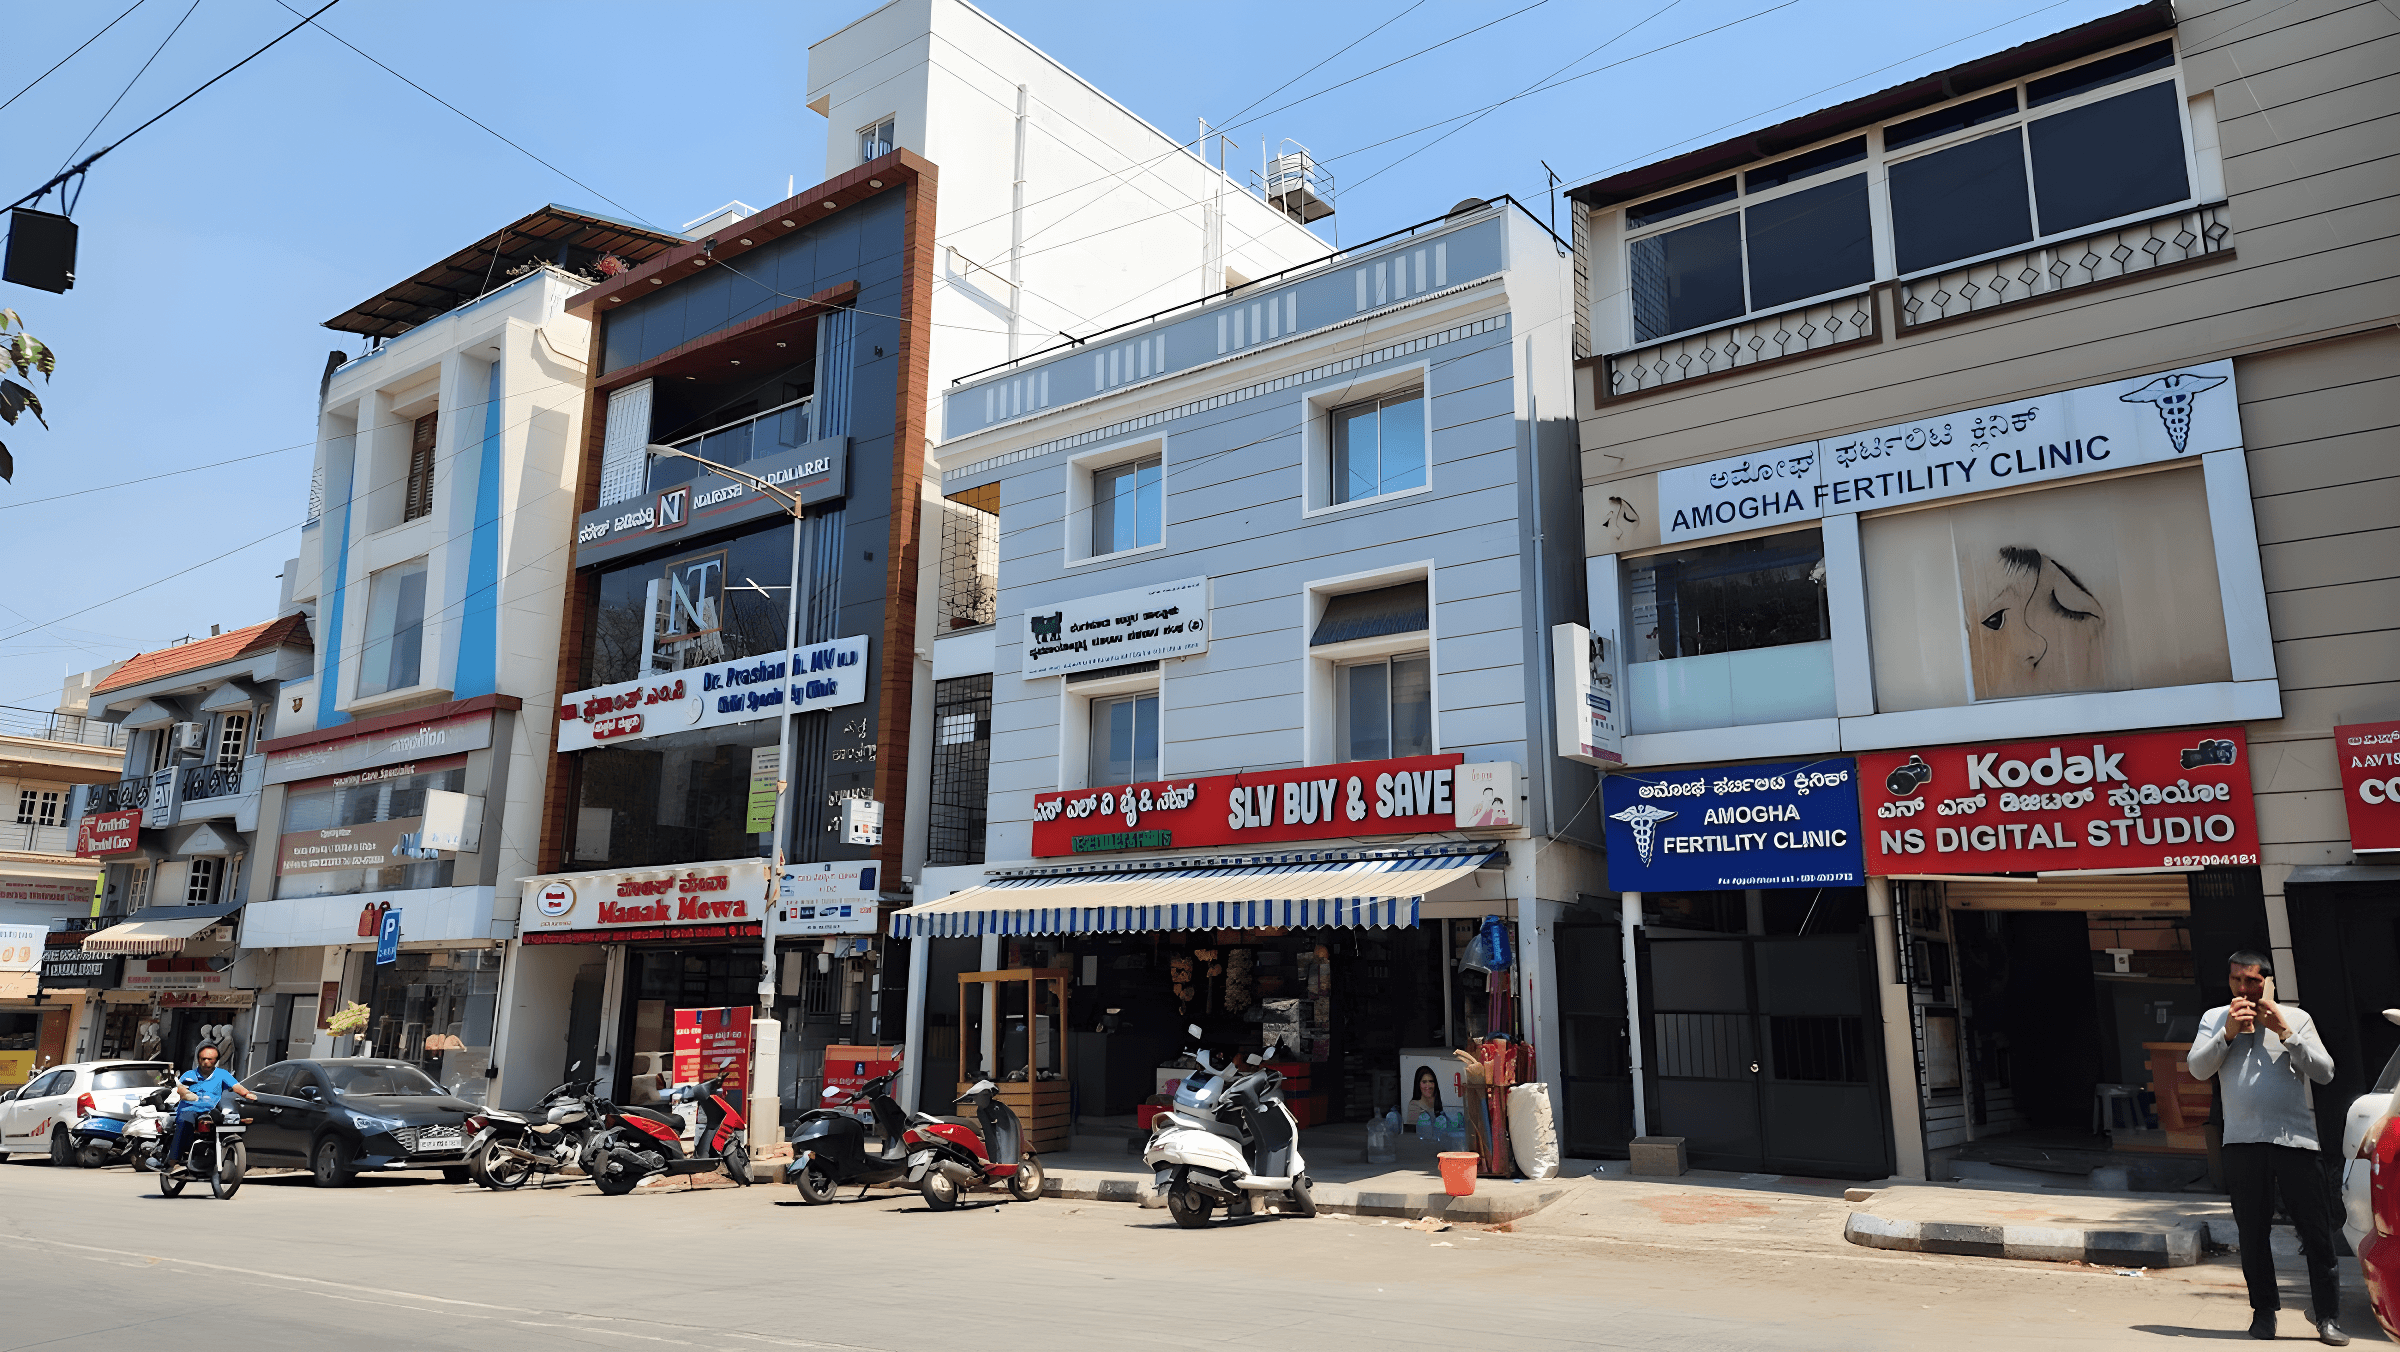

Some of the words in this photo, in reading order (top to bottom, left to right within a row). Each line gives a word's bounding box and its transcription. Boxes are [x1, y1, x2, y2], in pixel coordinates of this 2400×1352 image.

[1709, 449, 1815, 489] ಅಮೋಘ
[1971, 406, 2039, 452] ಕ್ಲಿನಿಕ್
[1671, 488, 1804, 532] AMOGHA
[1814, 458, 1977, 508] FERTILITY
[1990, 435, 2111, 477] CLINIC
[1966, 744, 2129, 790] Kodak
[1139, 788, 1153, 811] &
[1228, 783, 1276, 829] SLV
[1284, 778, 1338, 825] BUY
[1346, 776, 1367, 822] &
[1376, 769, 1453, 817] SAVE
[1638, 778, 1705, 798] ಅಮೋಘ
[1794, 770, 1848, 795] ಕ್ಲಿನಿಕ್
[1877, 797, 1926, 819] ಎನ್
[1937, 793, 1987, 816] ಎಸ್
[2108, 779, 2230, 818] ಸ್ಟುಡಿಯೋ
[1704, 804, 1800, 825] AMOGHA
[1664, 833, 1767, 853] FERTILITY
[1773, 829, 1847, 849] CLINIC
[1880, 829, 1926, 854] NS
[1936, 822, 2077, 852] DIGITAL
[2088, 815, 2235, 847] STUDIO
[597, 899, 671, 924] Manak
[385, 918, 396, 940] P
